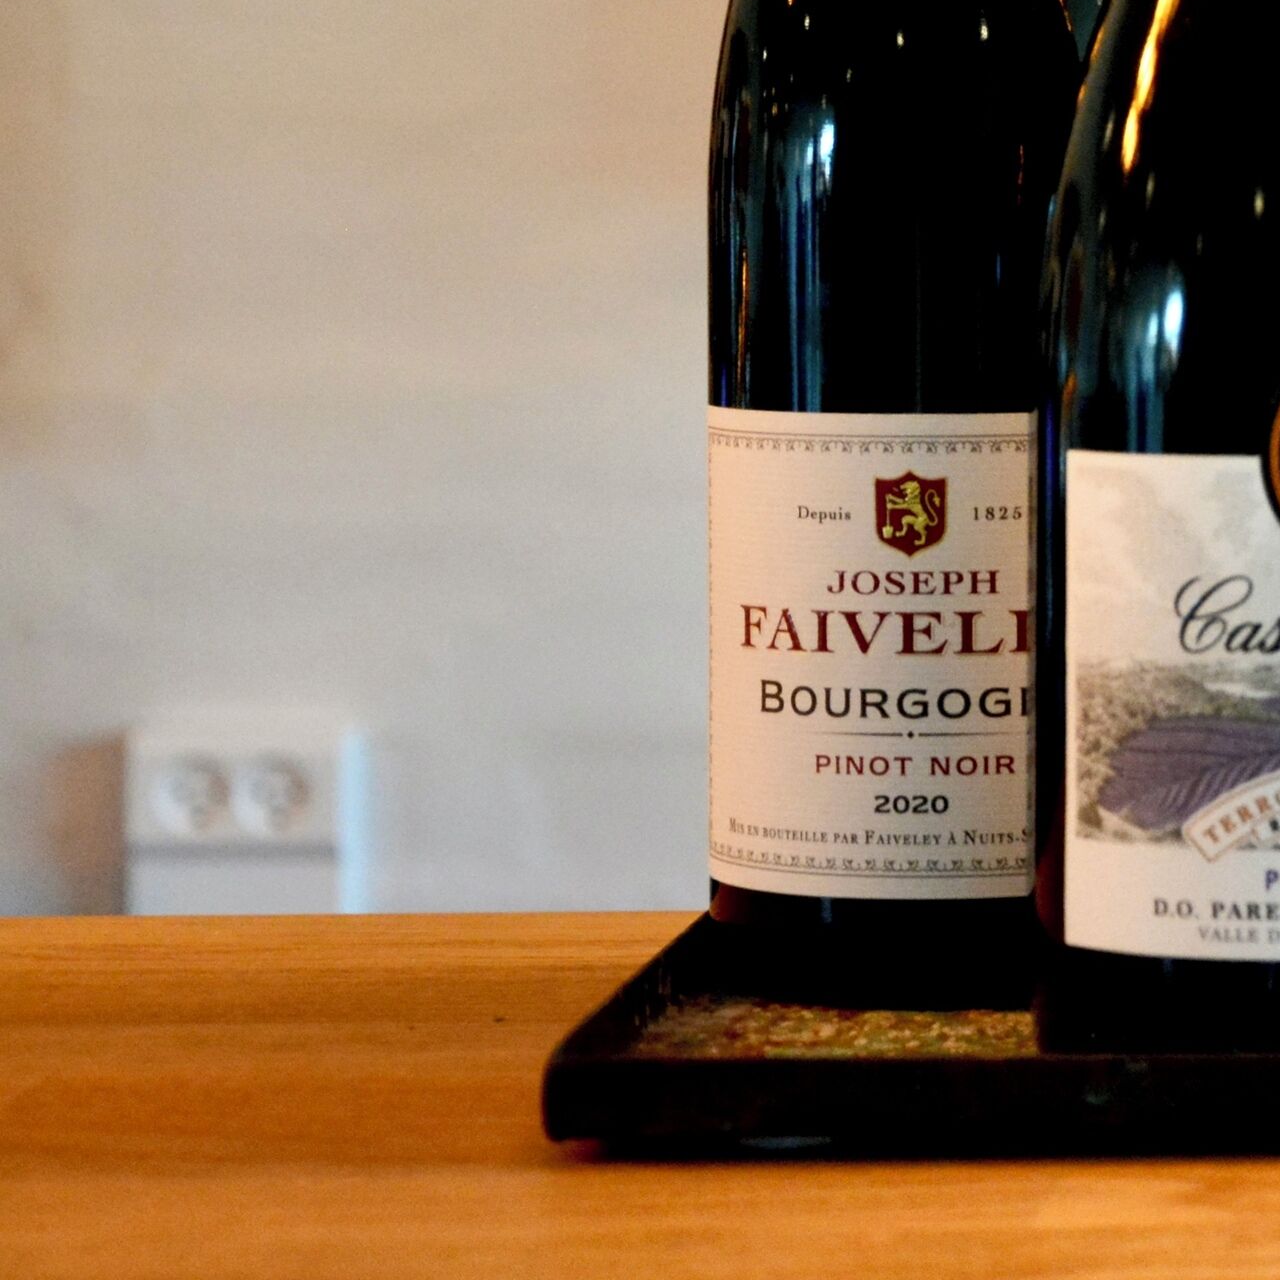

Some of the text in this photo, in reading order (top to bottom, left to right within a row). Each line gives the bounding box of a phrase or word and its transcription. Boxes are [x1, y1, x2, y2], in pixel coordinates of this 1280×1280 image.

[798, 506, 1022, 522] Depuis 1825
[827, 570, 1000, 595] JOSEPH
[815, 754, 1015, 776] PINOT NOIR
[874, 795, 949, 814] 2020
[834, 832, 858, 845] PAR
[865, 830, 942, 846] FAIVELEY
[1153, 898, 1200, 920] D.O.
[1199, 927, 1258, 945] VALLE
